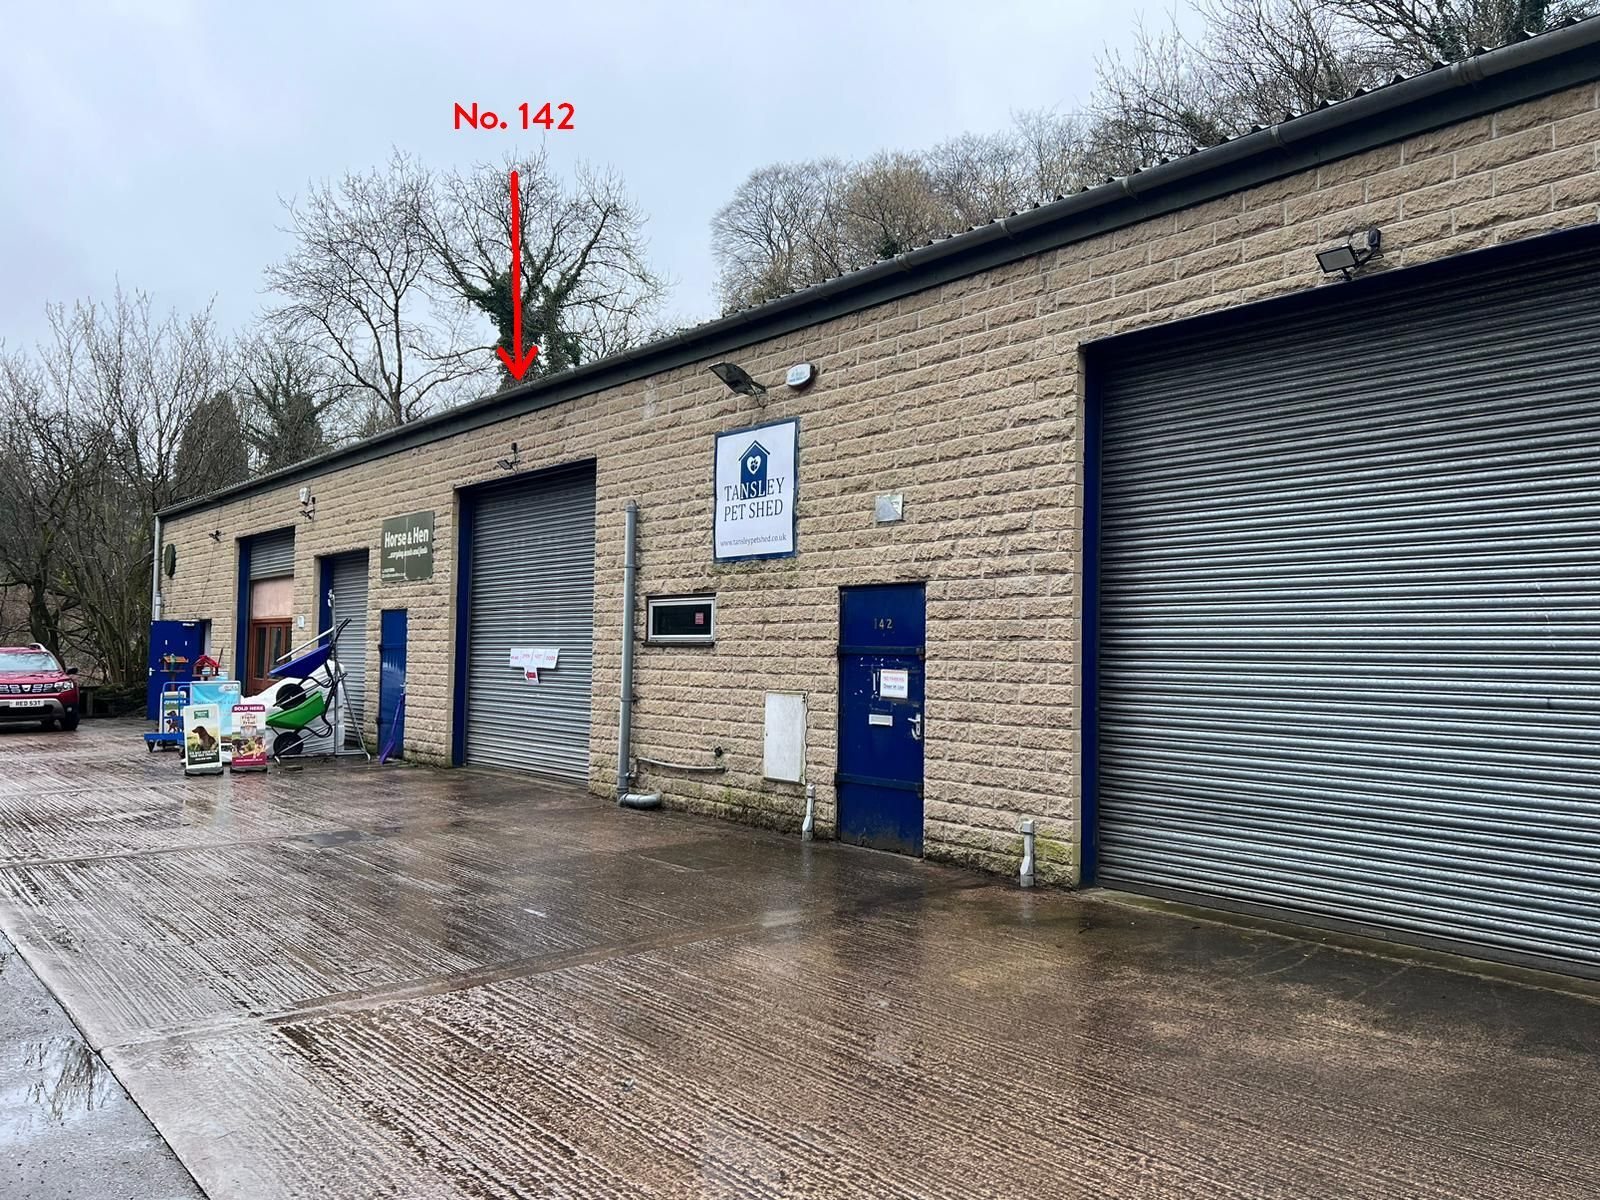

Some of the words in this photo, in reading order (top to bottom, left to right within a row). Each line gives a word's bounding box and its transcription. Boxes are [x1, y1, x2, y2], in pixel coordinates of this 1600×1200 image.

[724, 476, 785, 502] TANSLEY
[723, 503, 747, 522] PET
[748, 498, 784, 519] SHED
[384, 531, 407, 549] Horse
[407, 531, 413, 545] &
[413, 526, 429, 544] Hen
[720, 533, 787, 547] www.tansleypetshed.co.uk
[873, 617, 893, 630] 142
